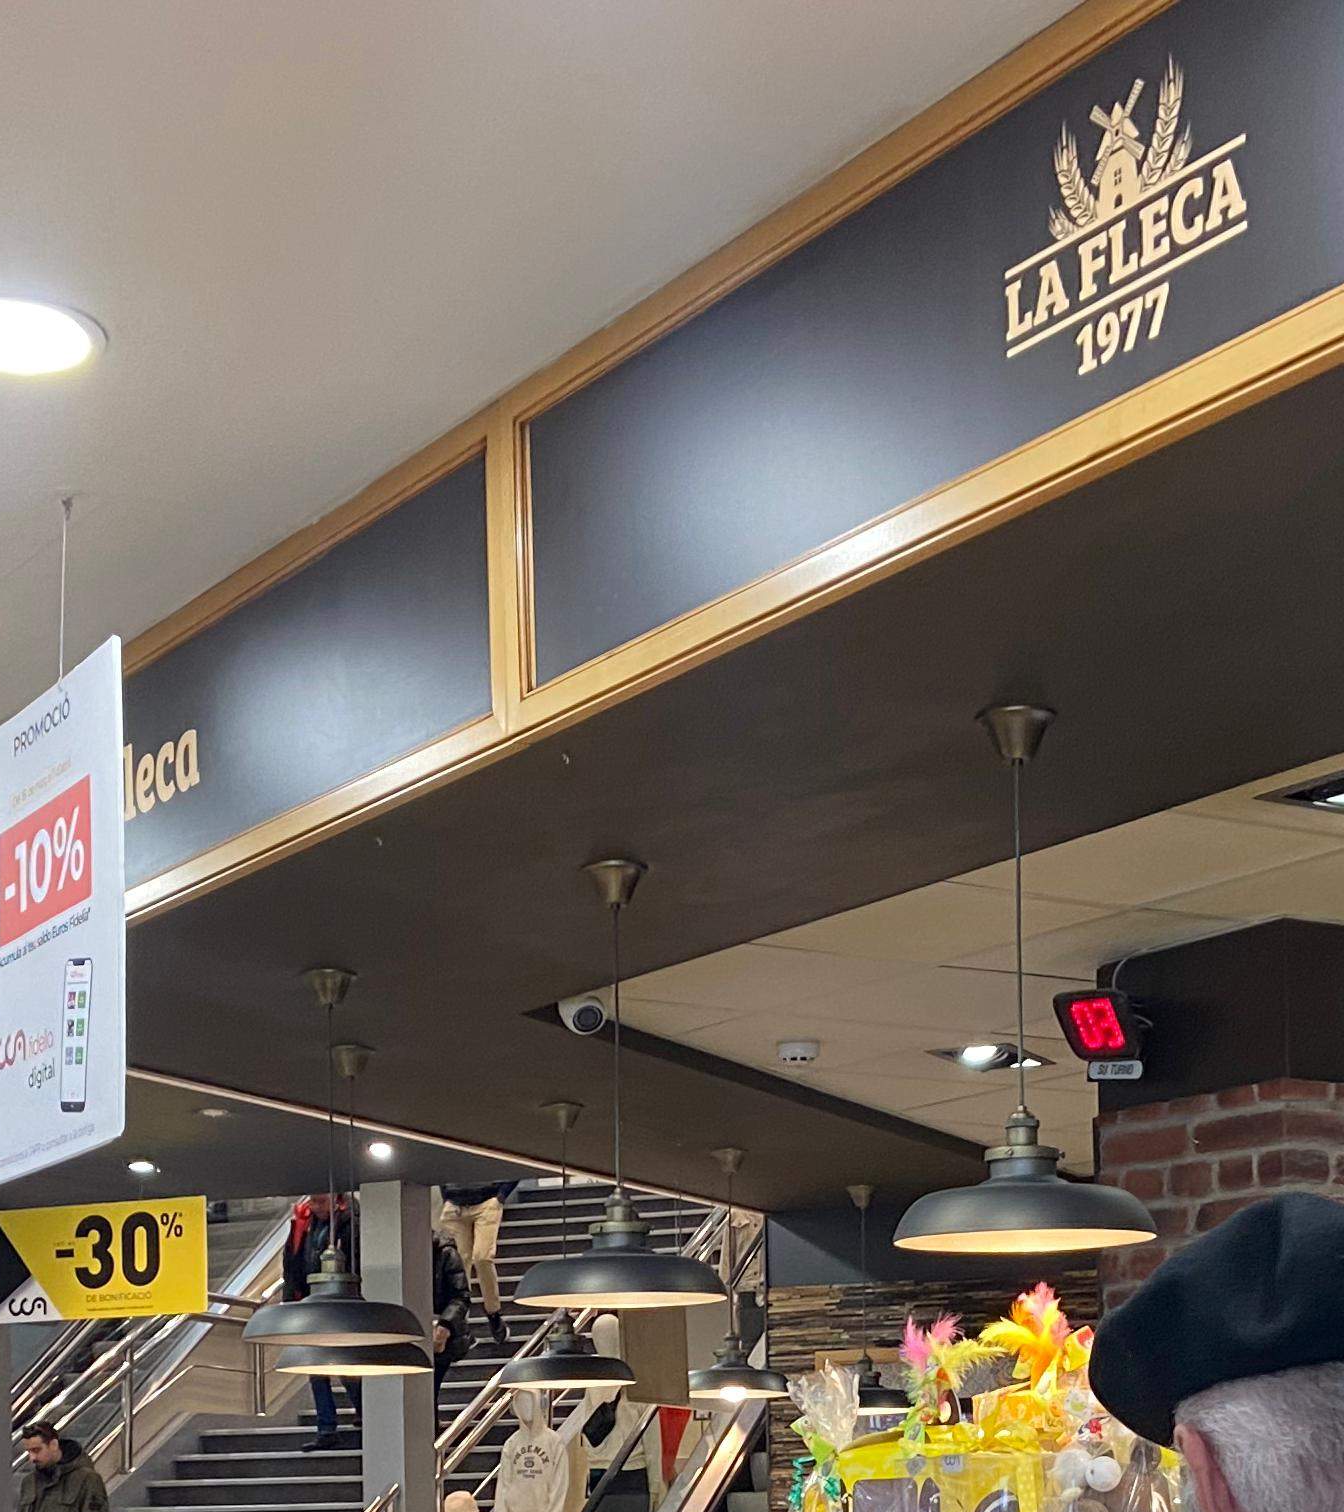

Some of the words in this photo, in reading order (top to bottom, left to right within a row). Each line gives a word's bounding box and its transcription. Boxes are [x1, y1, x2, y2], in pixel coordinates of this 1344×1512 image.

[1006, 260, 1070, 341] LA
[1078, 158, 1248, 301] FLECA
[1076, 281, 1169, 376] 1977
[13, 692, 70, 757] PROMOCIÓ
[122, 728, 201, 823] leca
[4, 805, 86, 914] -10%
